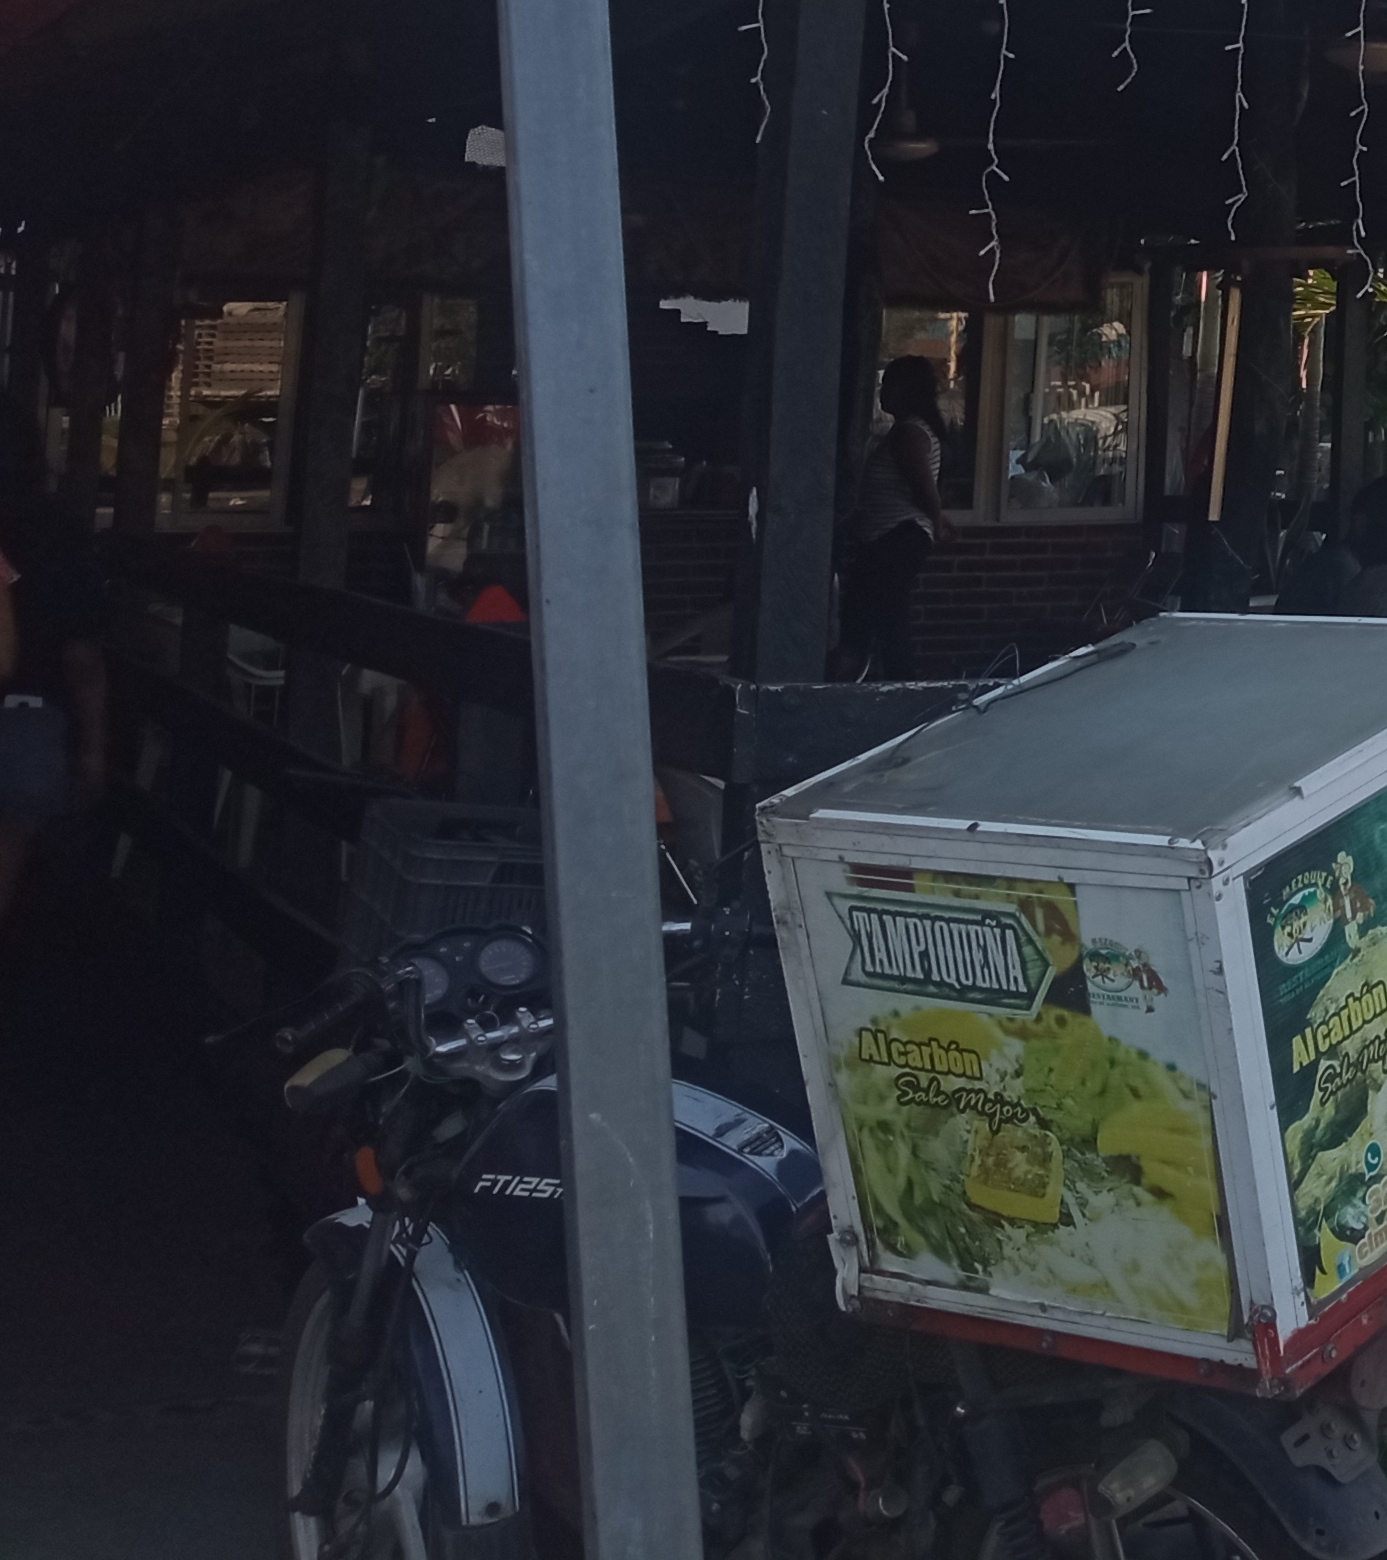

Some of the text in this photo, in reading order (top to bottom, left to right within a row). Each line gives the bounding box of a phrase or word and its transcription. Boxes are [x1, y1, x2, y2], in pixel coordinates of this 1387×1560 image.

[852, 910, 1028, 993] TAMPIQUEÑA
[861, 1030, 982, 1078] Al carbón
[1292, 1027, 1316, 1074] Al
[1316, 981, 1387, 1053] carbón
[898, 1077, 1028, 1129] Sabe Mejor
